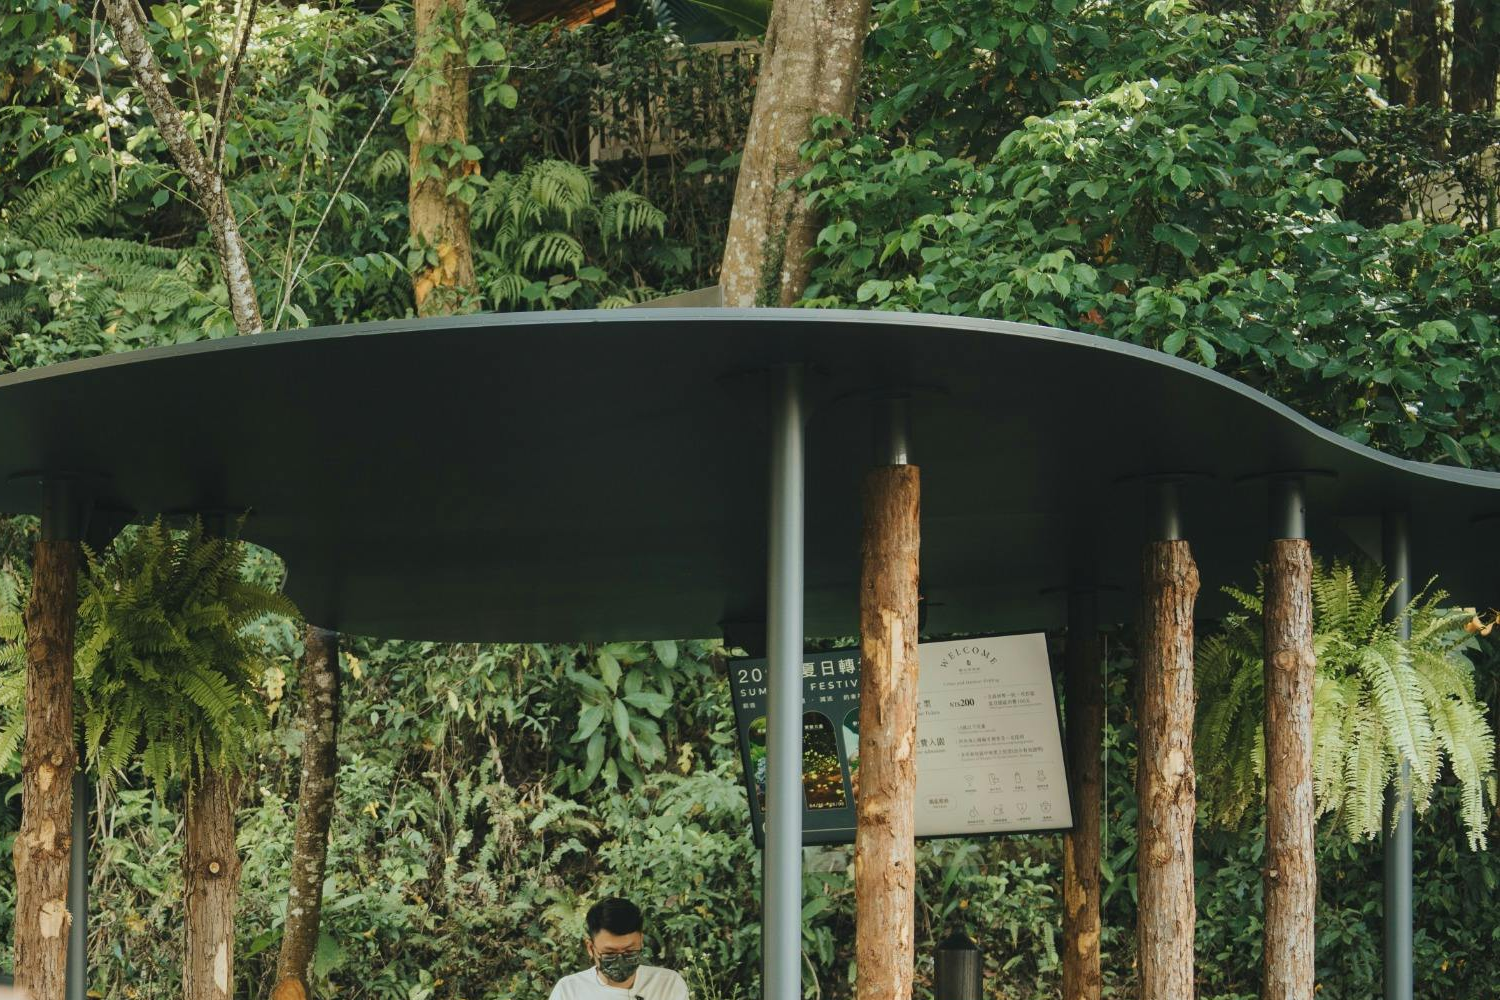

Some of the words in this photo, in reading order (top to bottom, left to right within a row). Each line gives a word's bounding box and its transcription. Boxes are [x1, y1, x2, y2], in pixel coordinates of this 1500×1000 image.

[940, 645, 998, 668] WELCOME
[738, 667, 767, 684] 20
[803, 658, 861, 678] 夏日轉
[740, 687, 767, 697] SUM
[810, 679, 859, 690] FESTIV
